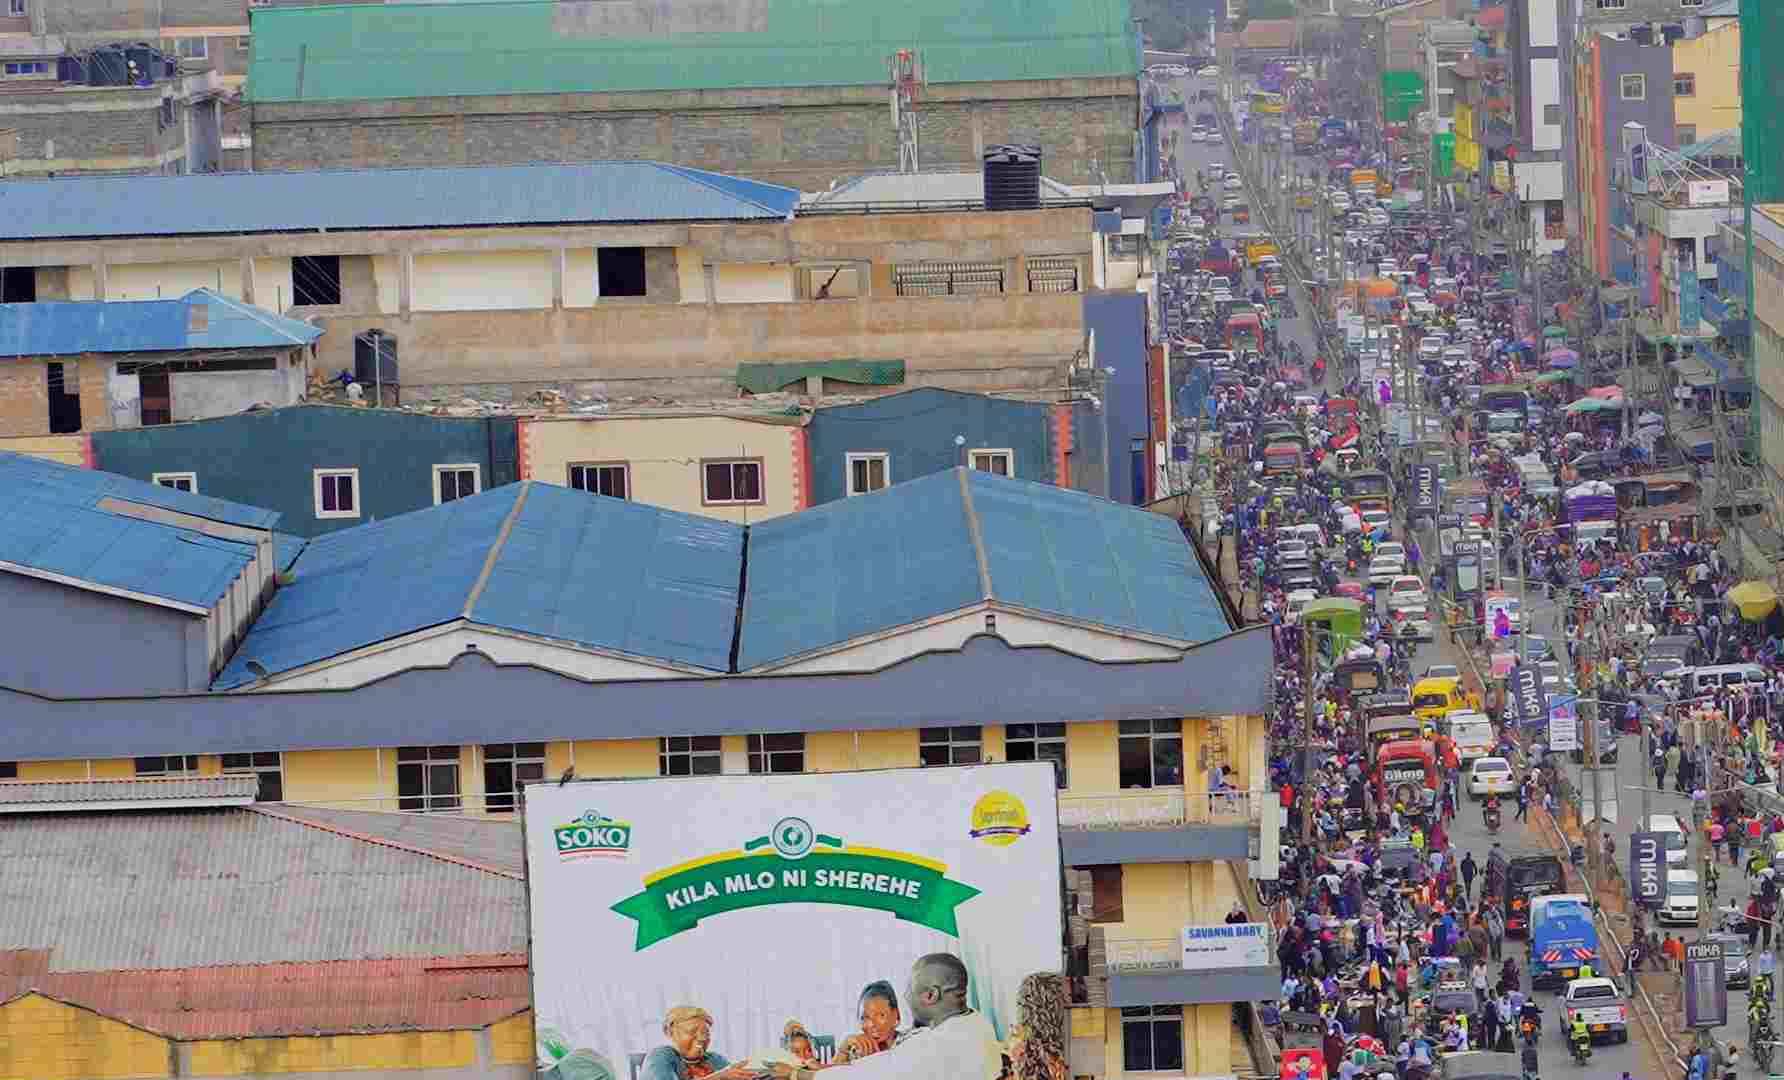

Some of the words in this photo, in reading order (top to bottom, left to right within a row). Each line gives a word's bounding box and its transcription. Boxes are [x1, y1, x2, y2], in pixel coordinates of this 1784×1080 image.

[557, 827, 627, 849] SOKO
[665, 884, 719, 911] KILA
[725, 871, 775, 895] MLO
[783, 869, 807, 888] NI
[815, 869, 921, 900] SHEREHE
[1188, 928, 1233, 939] SAVANNA
